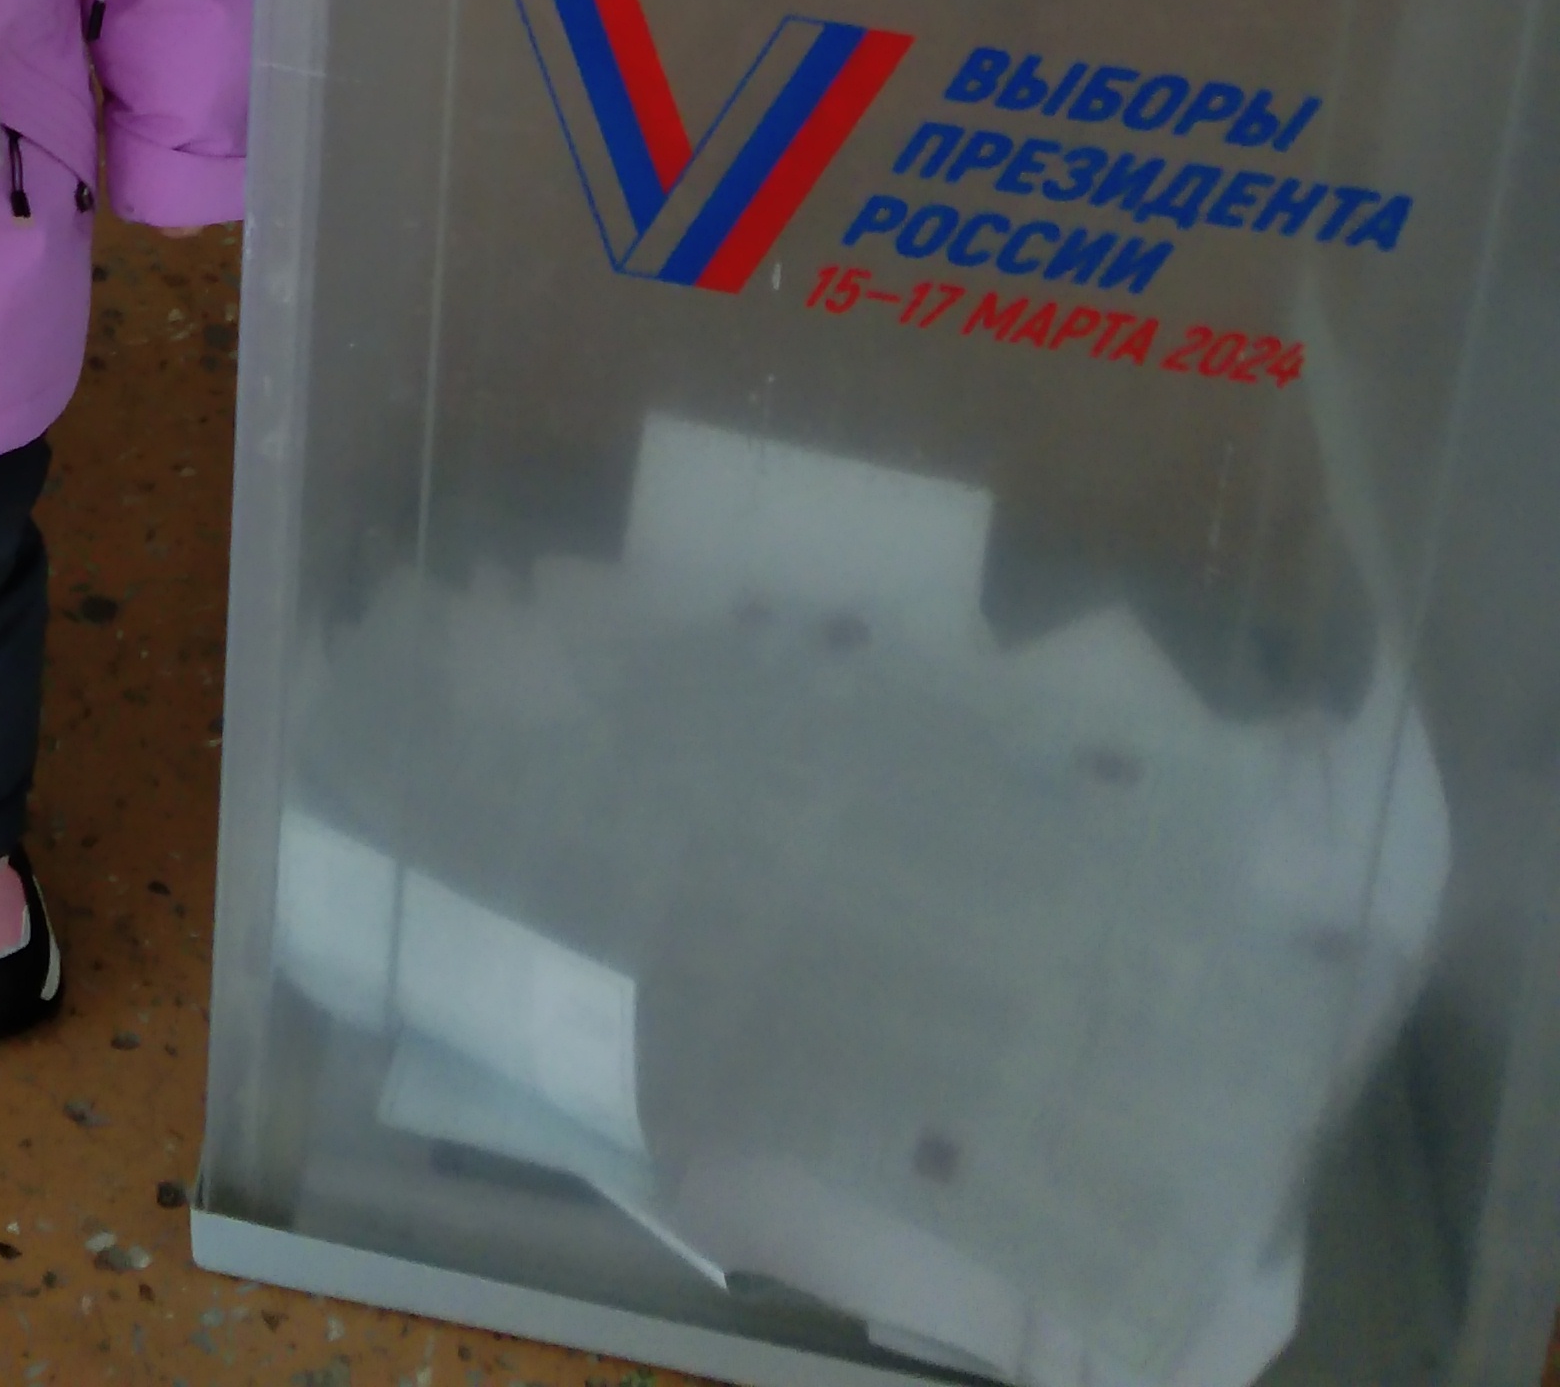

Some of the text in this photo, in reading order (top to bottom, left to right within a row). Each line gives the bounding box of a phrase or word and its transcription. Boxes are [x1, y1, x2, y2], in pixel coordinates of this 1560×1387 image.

[944, 46, 1322, 152] ВЫБОРЫ
[892, 121, 1414, 252] ПРЕЗИДЕНТА
[842, 194, 1175, 295] РОССИИ
[960, 291, 1159, 367] МАРТА
[1160, 324, 1306, 389] 2024
